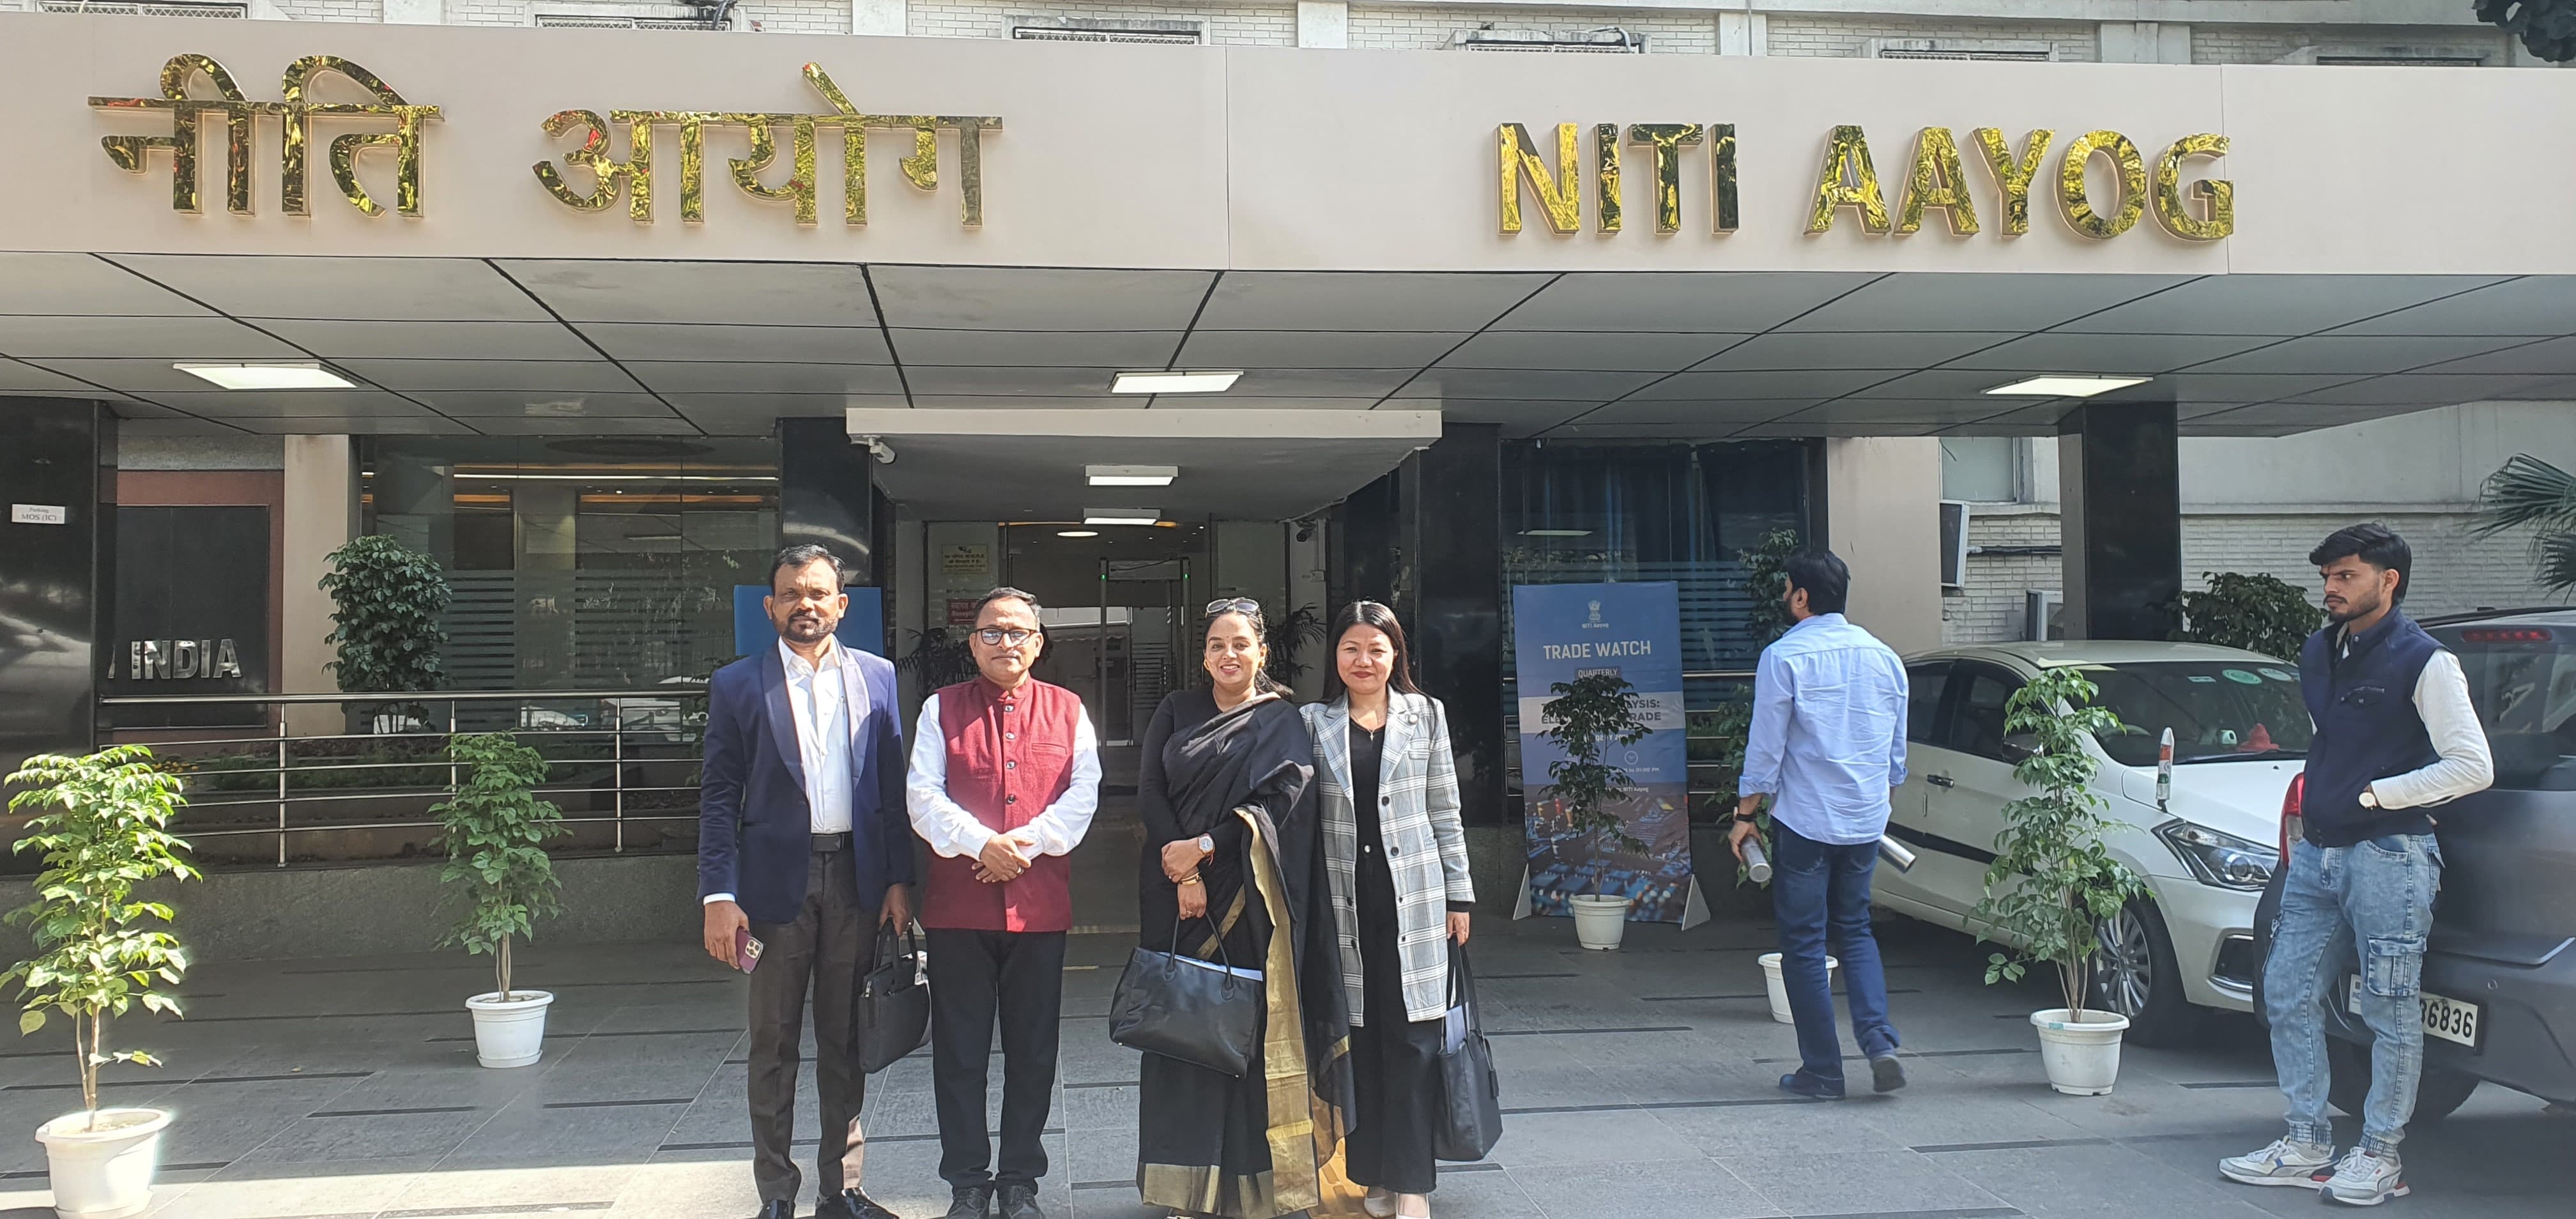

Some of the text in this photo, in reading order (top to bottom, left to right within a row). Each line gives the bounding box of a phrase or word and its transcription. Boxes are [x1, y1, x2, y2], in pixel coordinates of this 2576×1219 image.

[88, 53, 1004, 228] नीति आयोग
[1495, 122, 2235, 243] NITI AAYOG
[131, 639, 242, 680] INDIA
[1543, 640, 1652, 660] TRADE WATCH
[1578, 668, 1618, 678] QUARTERLY
[1629, 712, 1662, 722] RADE
